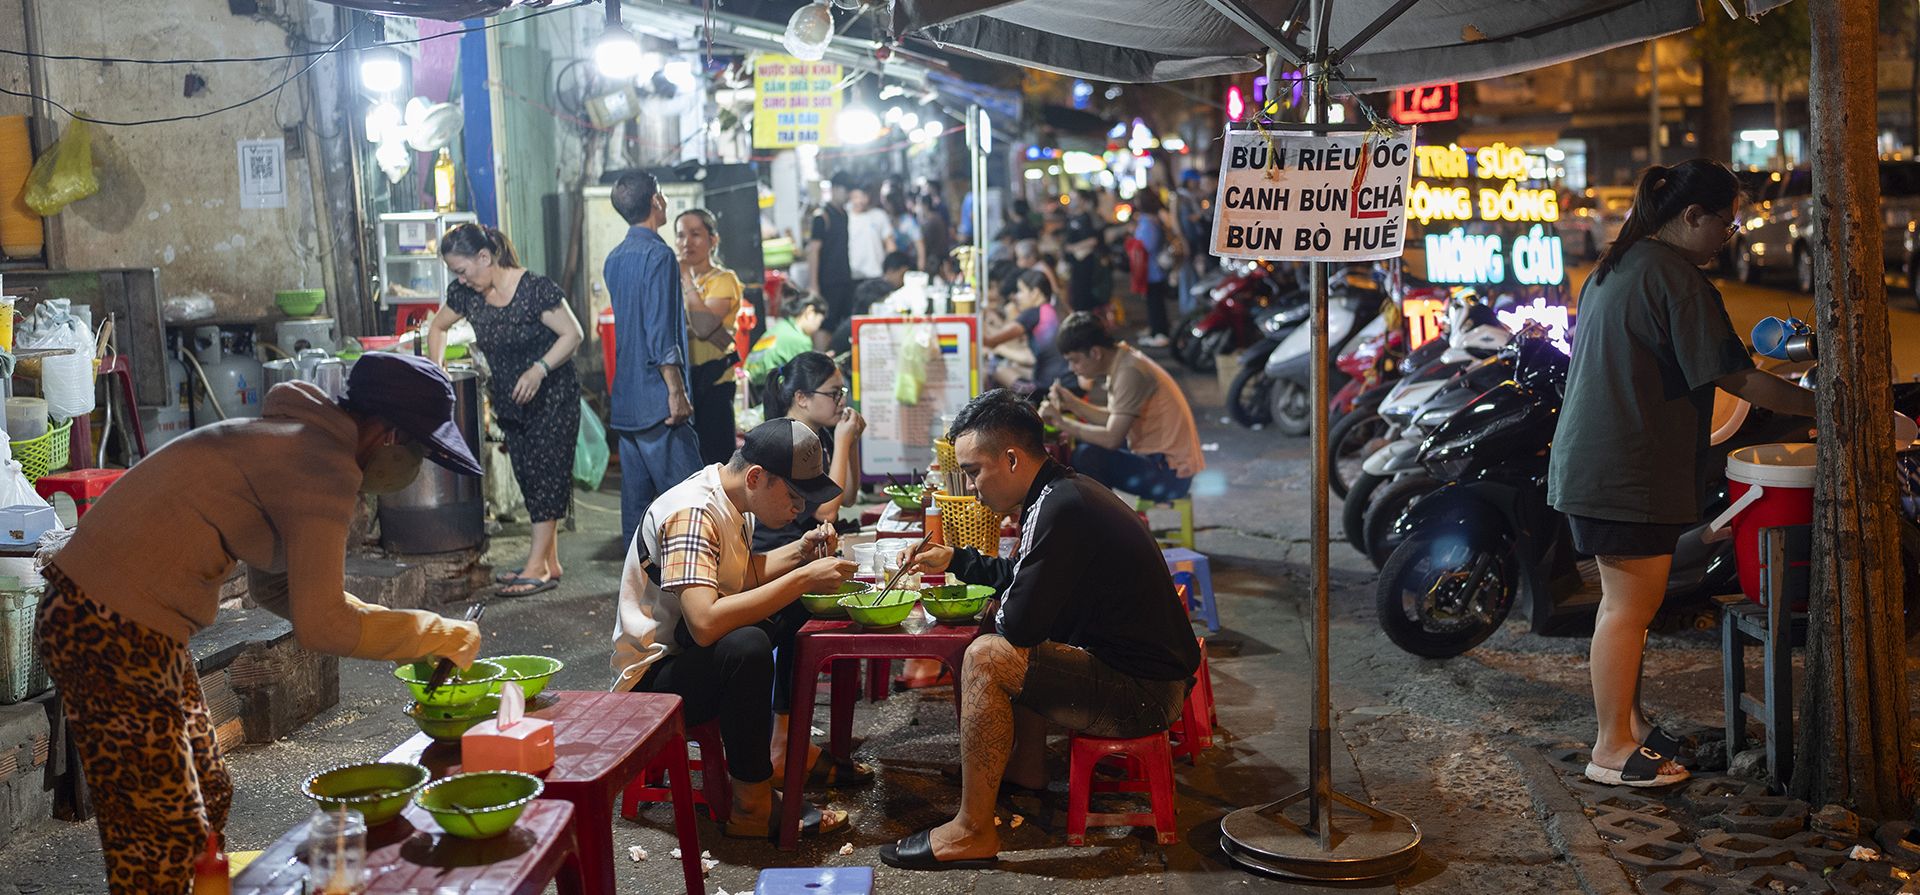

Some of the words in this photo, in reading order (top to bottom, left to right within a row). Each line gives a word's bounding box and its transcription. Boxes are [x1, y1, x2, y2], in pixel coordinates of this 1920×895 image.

[1231, 141, 1285, 170] BÚN
[1298, 143, 1361, 171] RIÊU
[1373, 137, 1408, 169] ỐC
[1225, 185, 1290, 211] CANH
[1299, 182, 1348, 212] BÚN
[1358, 176, 1403, 211] CHẢ
[1226, 221, 1283, 251] BÚN
[1294, 223, 1332, 252] BÒ
[1343, 216, 1400, 251] HUẾ
